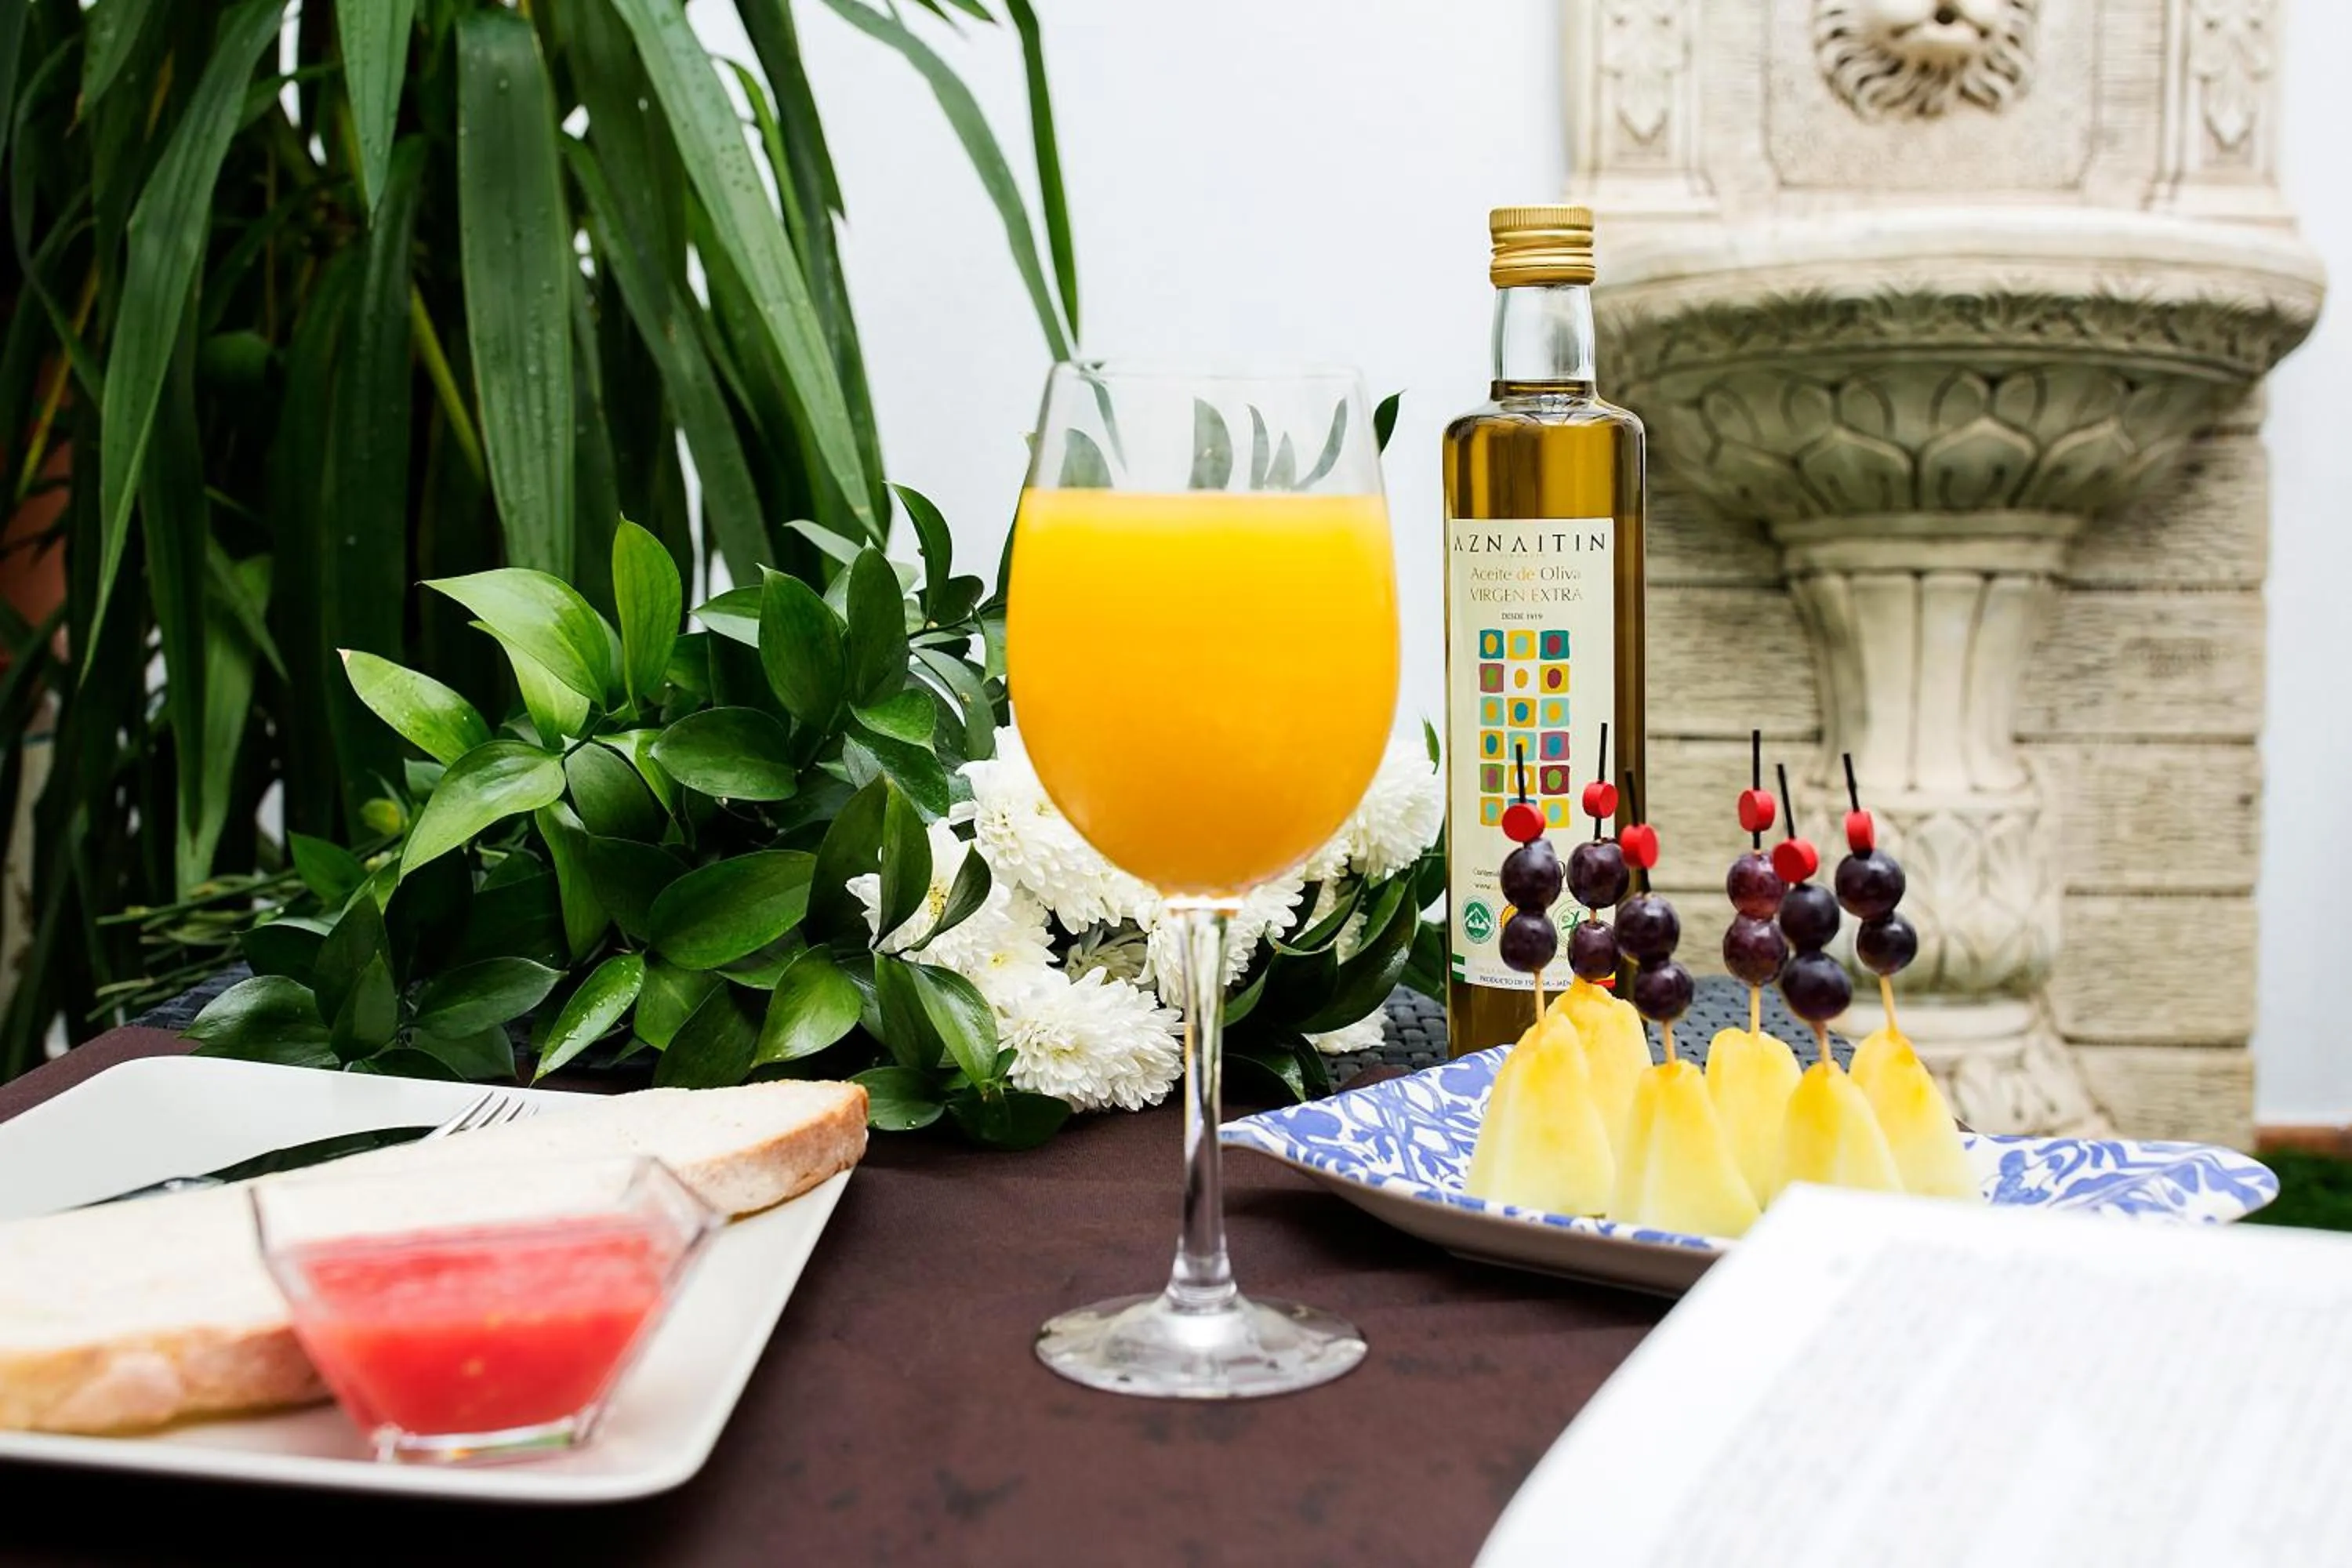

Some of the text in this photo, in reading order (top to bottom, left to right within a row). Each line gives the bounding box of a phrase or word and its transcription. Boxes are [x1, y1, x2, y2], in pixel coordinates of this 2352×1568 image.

[1470, 566, 1581, 582] Aceite de Oliva
[1469, 588, 1584, 602] VIRGEN EXTRA
